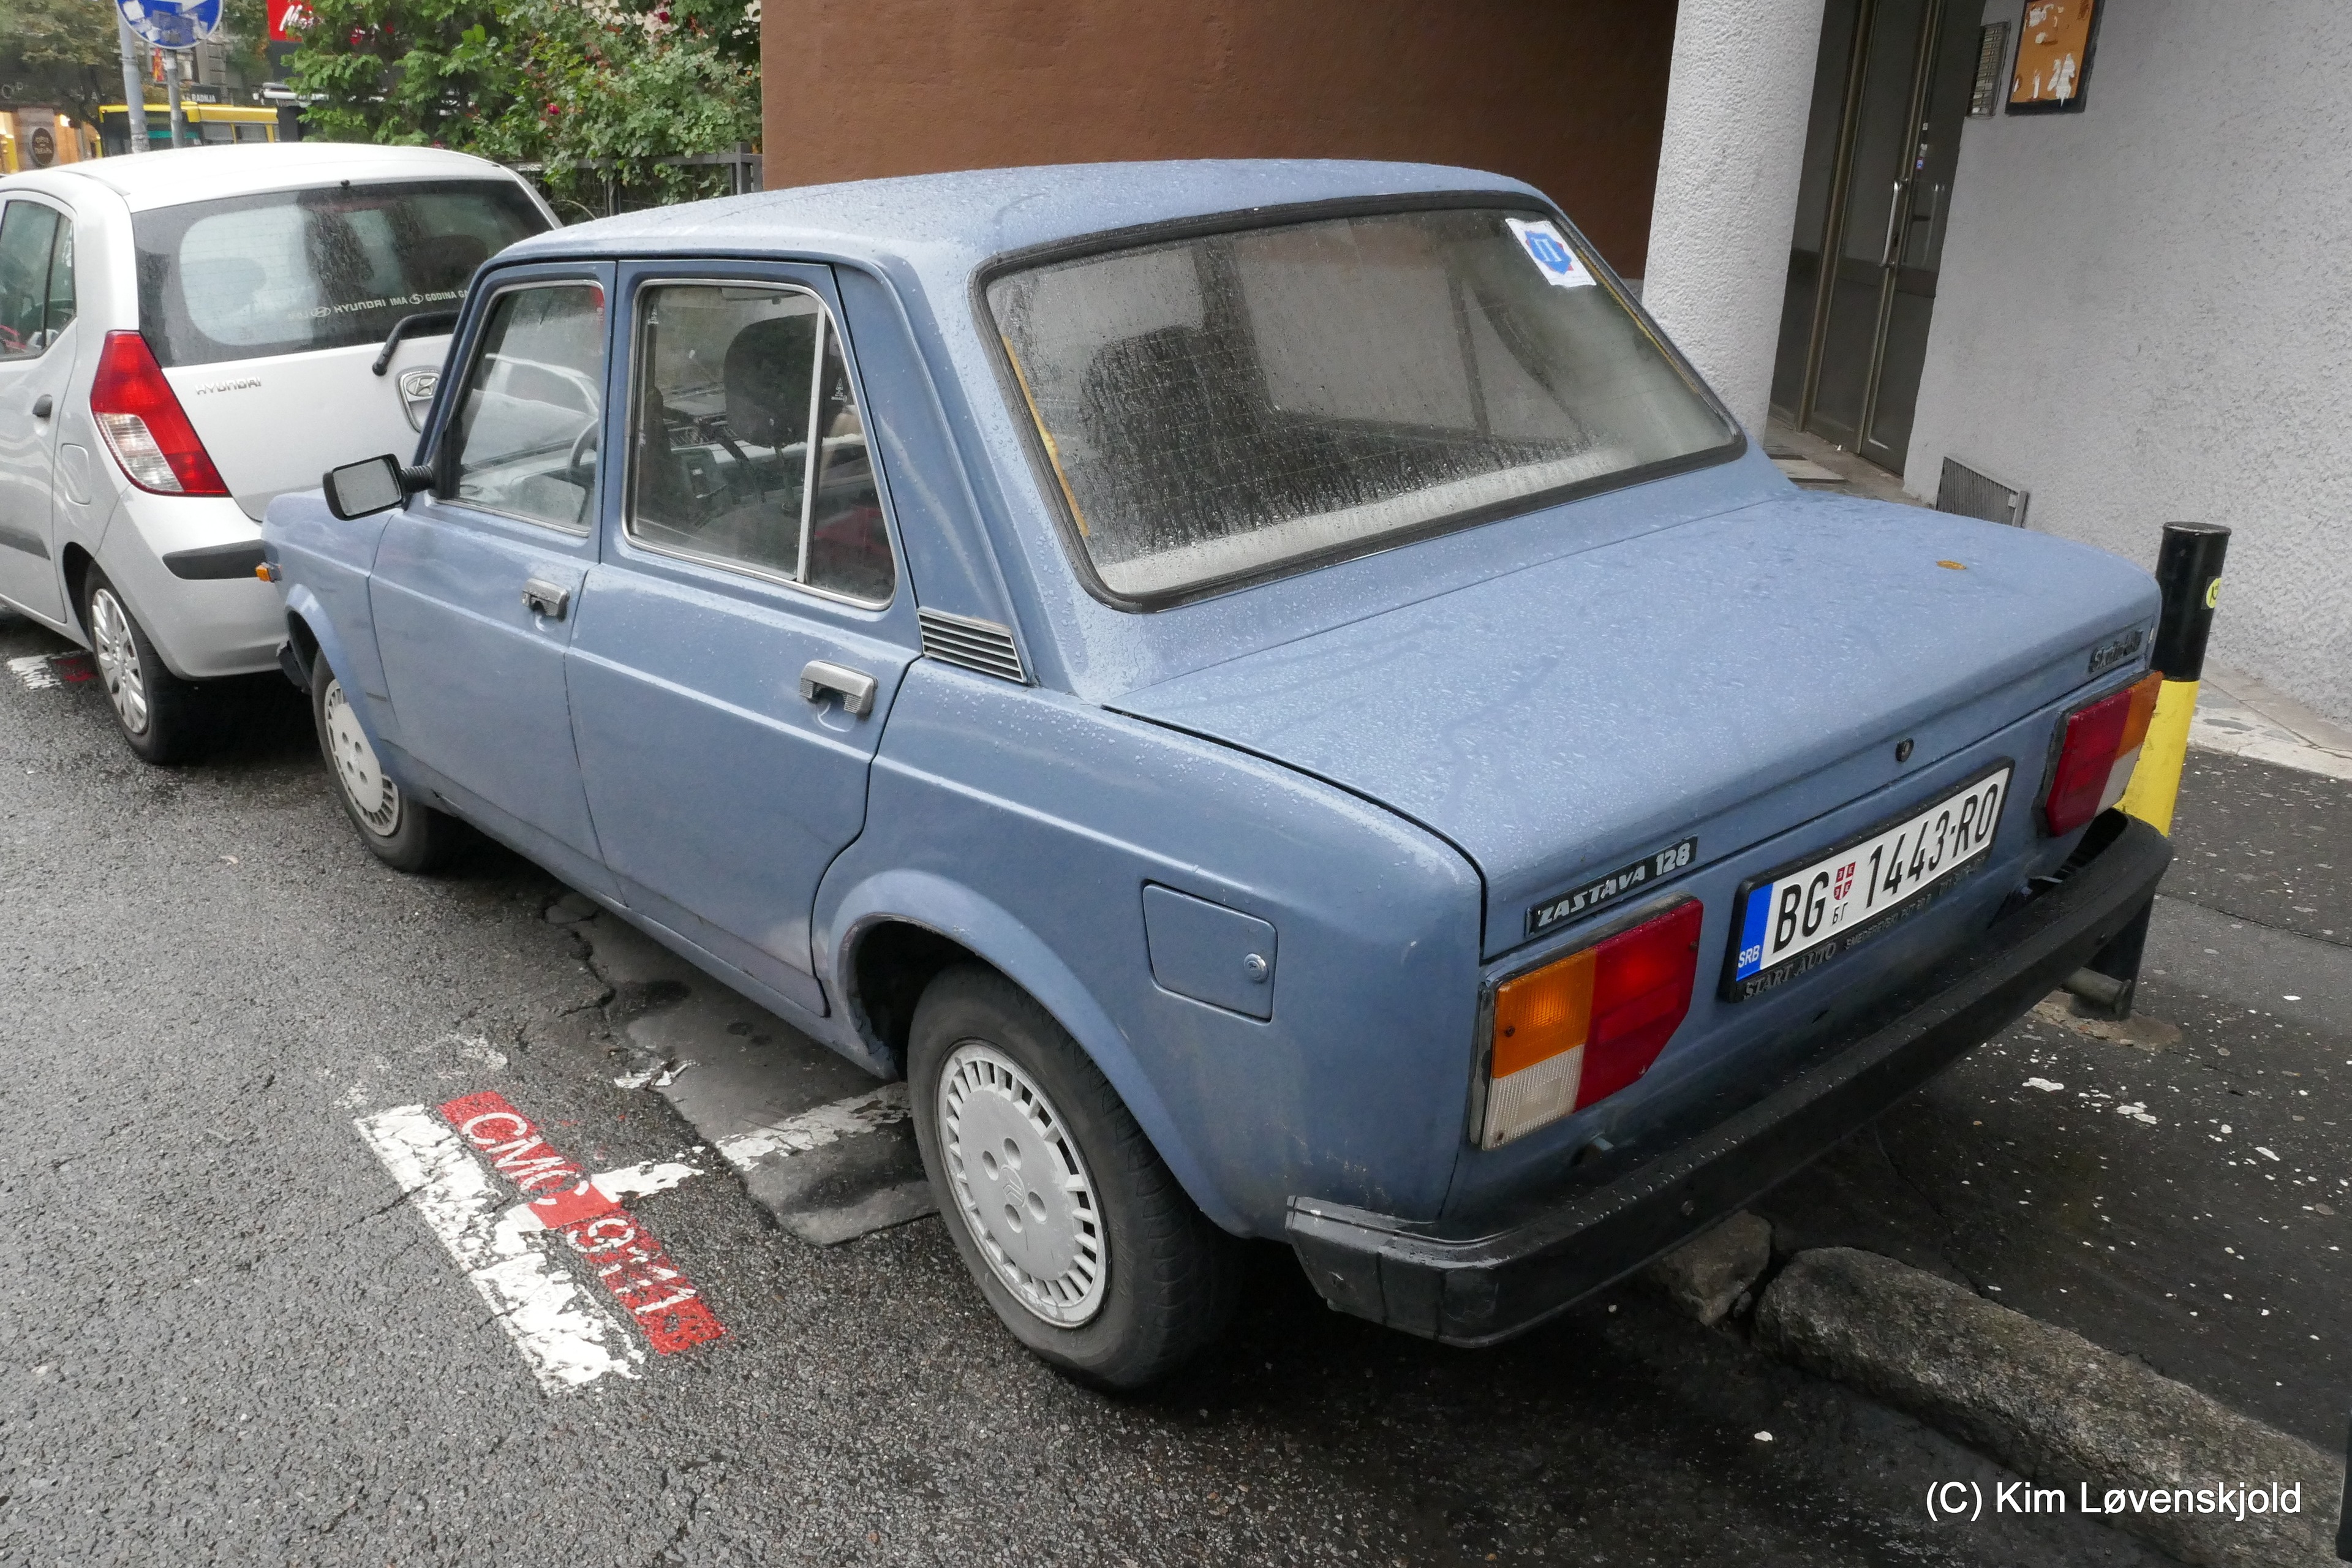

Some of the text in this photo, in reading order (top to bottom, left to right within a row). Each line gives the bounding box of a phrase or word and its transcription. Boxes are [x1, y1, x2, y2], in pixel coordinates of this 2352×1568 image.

[334, 299, 386, 313] HYUNDAI
[390, 296, 408, 306] IMA
[425, 291, 457, 301] GODINA
[195, 376, 262, 395] HYUNDAI
[1537, 842, 1691, 927] ZASTAVA 128
[1773, 783, 1999, 954] BG 1443-RO
[1738, 944, 1760, 968] SRB
[1743, 963, 1794, 1001] START
[1794, 942, 1837, 976] AUTO
